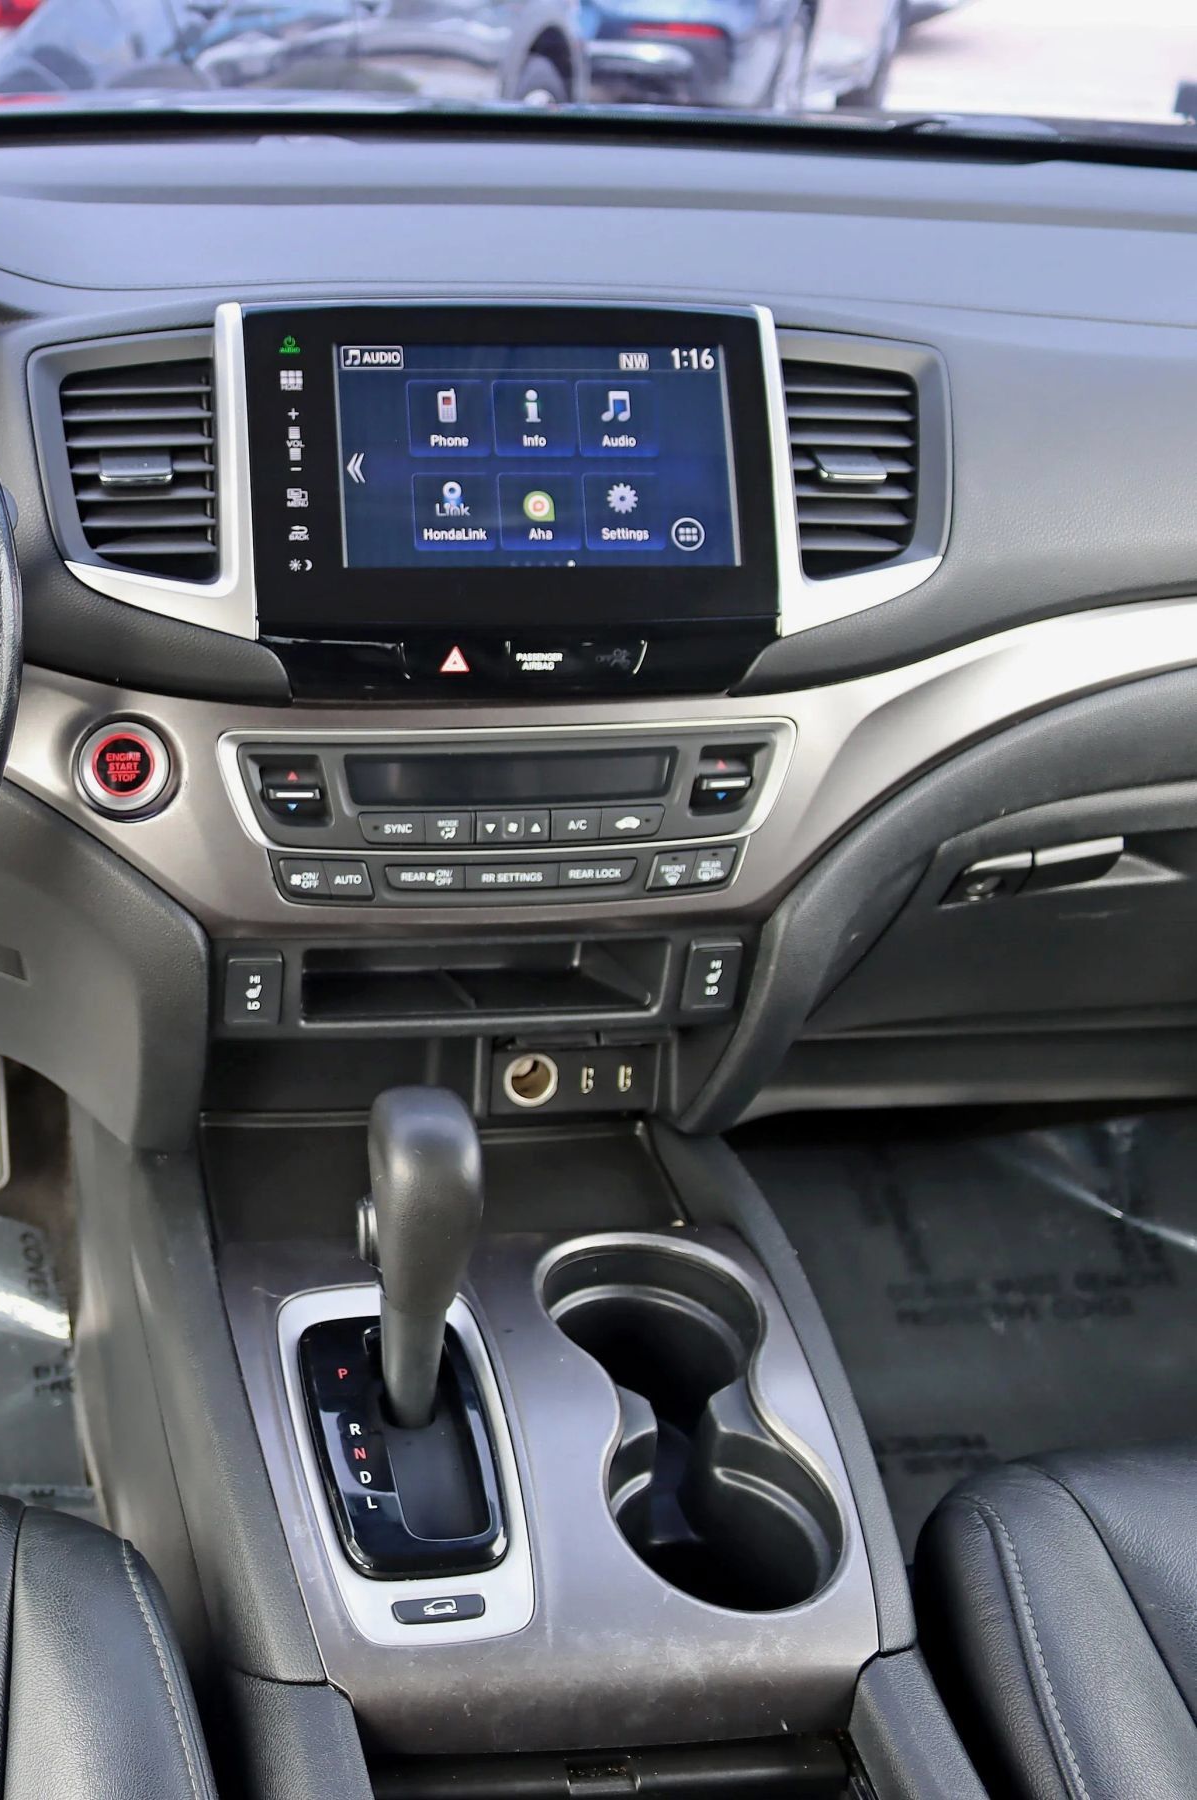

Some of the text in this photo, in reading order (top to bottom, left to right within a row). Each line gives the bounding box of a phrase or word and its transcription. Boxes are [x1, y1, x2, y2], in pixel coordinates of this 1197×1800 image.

[362, 351, 401, 364] AUDIO
[621, 353, 648, 369] NW
[671, 348, 715, 370] 1:16
[281, 383, 303, 391] HOME
[286, 440, 306, 448] VOL
[430, 434, 470, 447] Phone
[522, 434, 547, 447] Info
[601, 434, 637, 448] Audio
[435, 503, 471, 517] Link
[289, 533, 310, 541] BACK
[423, 527, 487, 541] HondaLink
[528, 527, 553, 541] Aha
[601, 527, 650, 543] Settings
[516, 653, 563, 662] PASSENGER
[521, 661, 555, 671] AIRBAG
[106, 752, 141, 761] ENGINE
[108, 762, 139, 771] START
[111, 773, 137, 782] STOP
[383, 823, 413, 834] SYNC
[437, 819, 459, 828] MODE
[567, 819, 588, 830] A/C
[660, 864, 686, 873] FRONT
[701, 860, 722, 869] REAR
[334, 874, 362, 885] AUTO
[400, 872, 426, 882] REAR
[496, 871, 543, 883] SETTINGS
[568, 868, 621, 880] REAR LOCK
[301, 880, 320, 889] OFF
[435, 877, 454, 886] OFF
[337, 1367, 349, 1380] P
[349, 1423, 362, 1435] R
[354, 1447, 367, 1460] N
[359, 1470, 372, 1485] D
[366, 1496, 378, 1510] L
